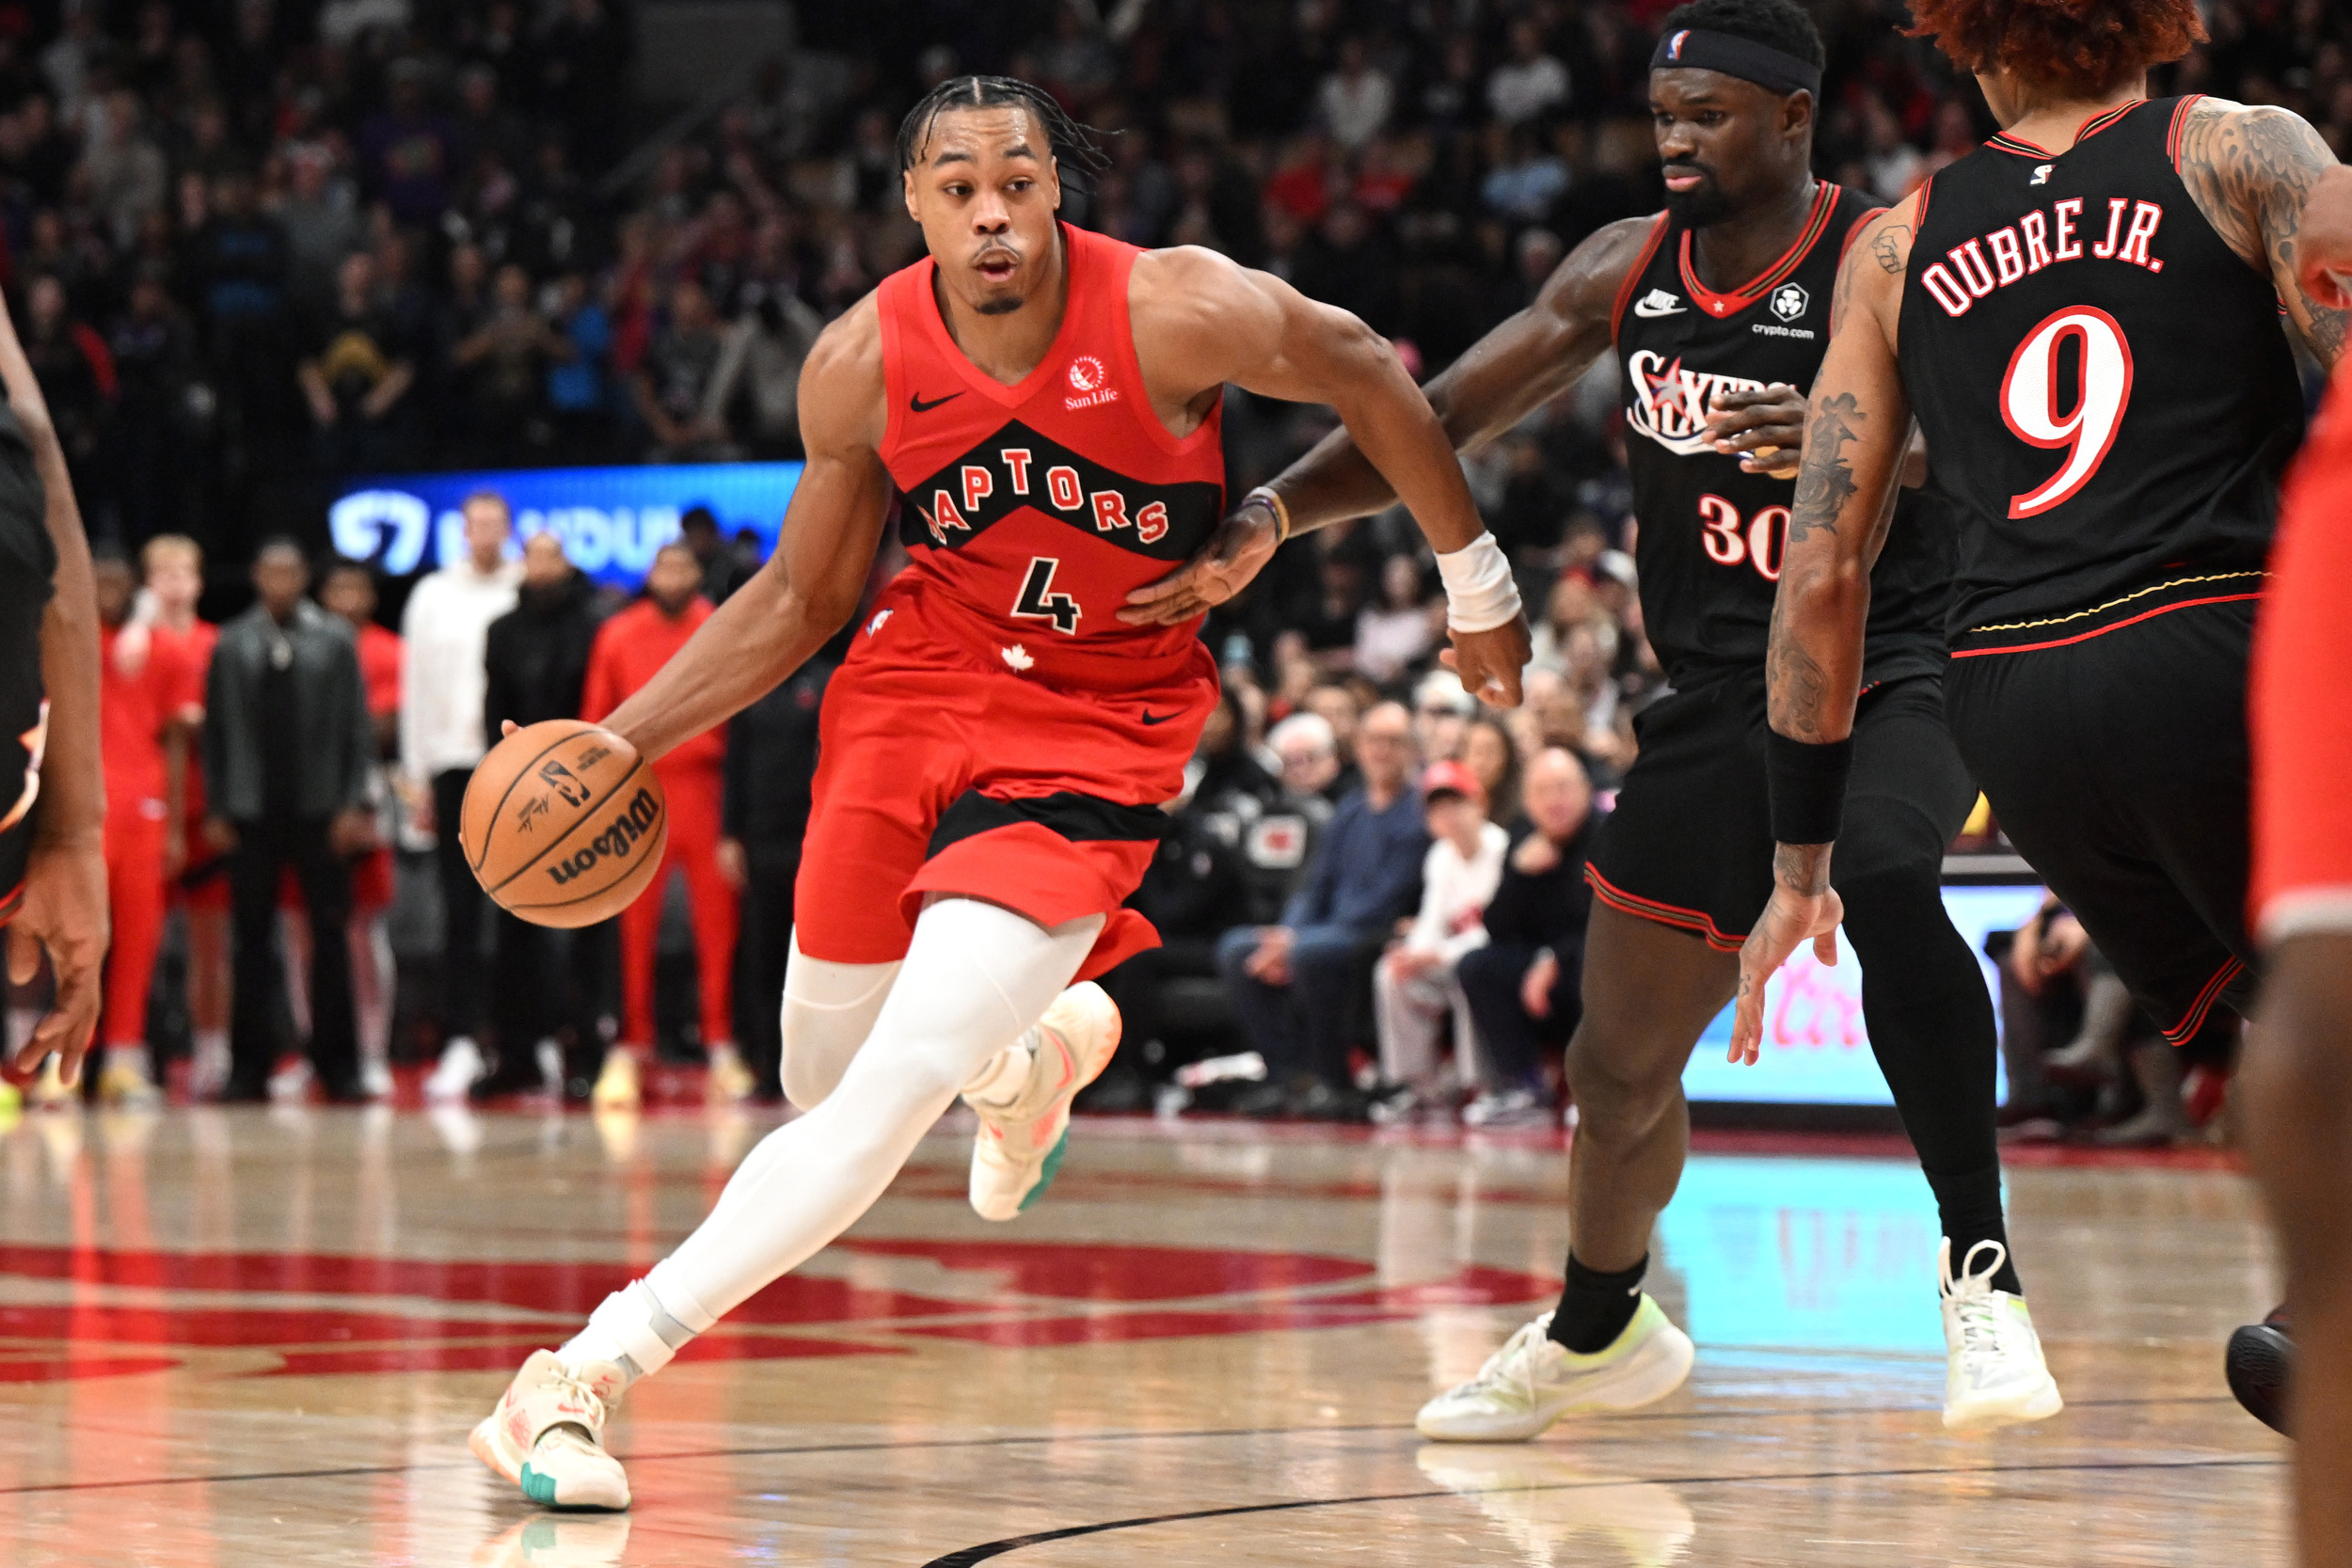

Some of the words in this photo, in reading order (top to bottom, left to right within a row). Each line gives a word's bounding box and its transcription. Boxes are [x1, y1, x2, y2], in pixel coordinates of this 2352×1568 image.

[1645, 288, 1680, 310] NIKE
[1920, 197, 2084, 317] OUBRE
[2091, 198, 2164, 274] JR.
[1752, 324, 1815, 340] crypto.com
[1065, 396, 1091, 411] Sun
[1092, 388, 1118, 404] Life
[1999, 305, 2134, 519] 9
[1698, 493, 1792, 582] 30
[1009, 556, 1083, 636] 4
[546, 787, 660, 885] Wilson
